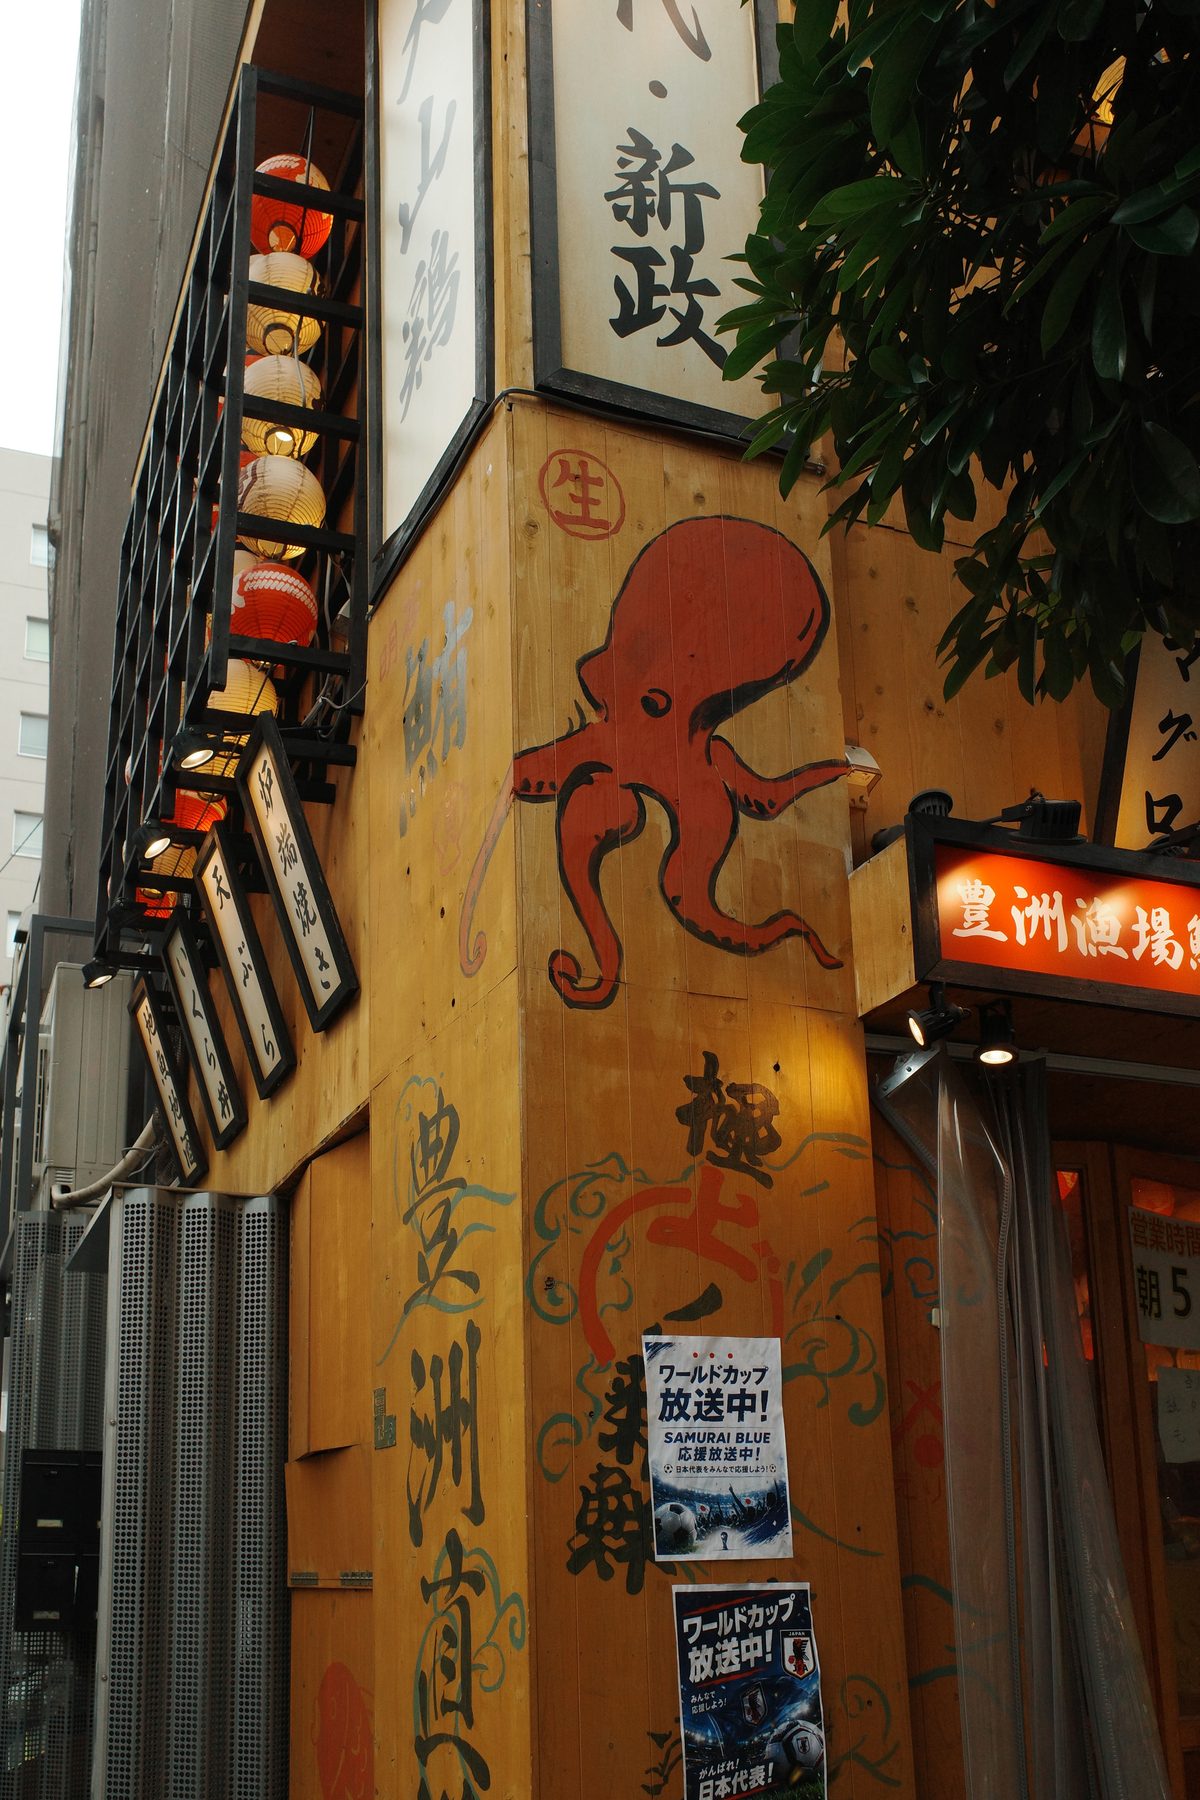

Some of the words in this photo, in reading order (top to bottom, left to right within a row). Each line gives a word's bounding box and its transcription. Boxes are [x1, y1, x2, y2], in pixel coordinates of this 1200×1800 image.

[552, 458, 611, 531] 生
[258, 759, 331, 990] 炉端焼き
[176, 946, 231, 1120] いくら丼
[659, 1364, 769, 1386] ワールドカップ
[658, 1387, 769, 1423] 放送中!
[403, 1087, 491, 1800] 豊洲直
[664, 1432, 731, 1444] SAMURAI
[736, 1432, 770, 1444] BLUE
[678, 1446, 761, 1462] 応援放送中!
[683, 1593, 796, 1644] ワールドカップ
[688, 1629, 773, 1684] 放送中!
[690, 1690, 716, 1704] みんなで
[699, 1758, 740, 1780] がんばれ!
[699, 1762, 774, 1800] 日本代表!
